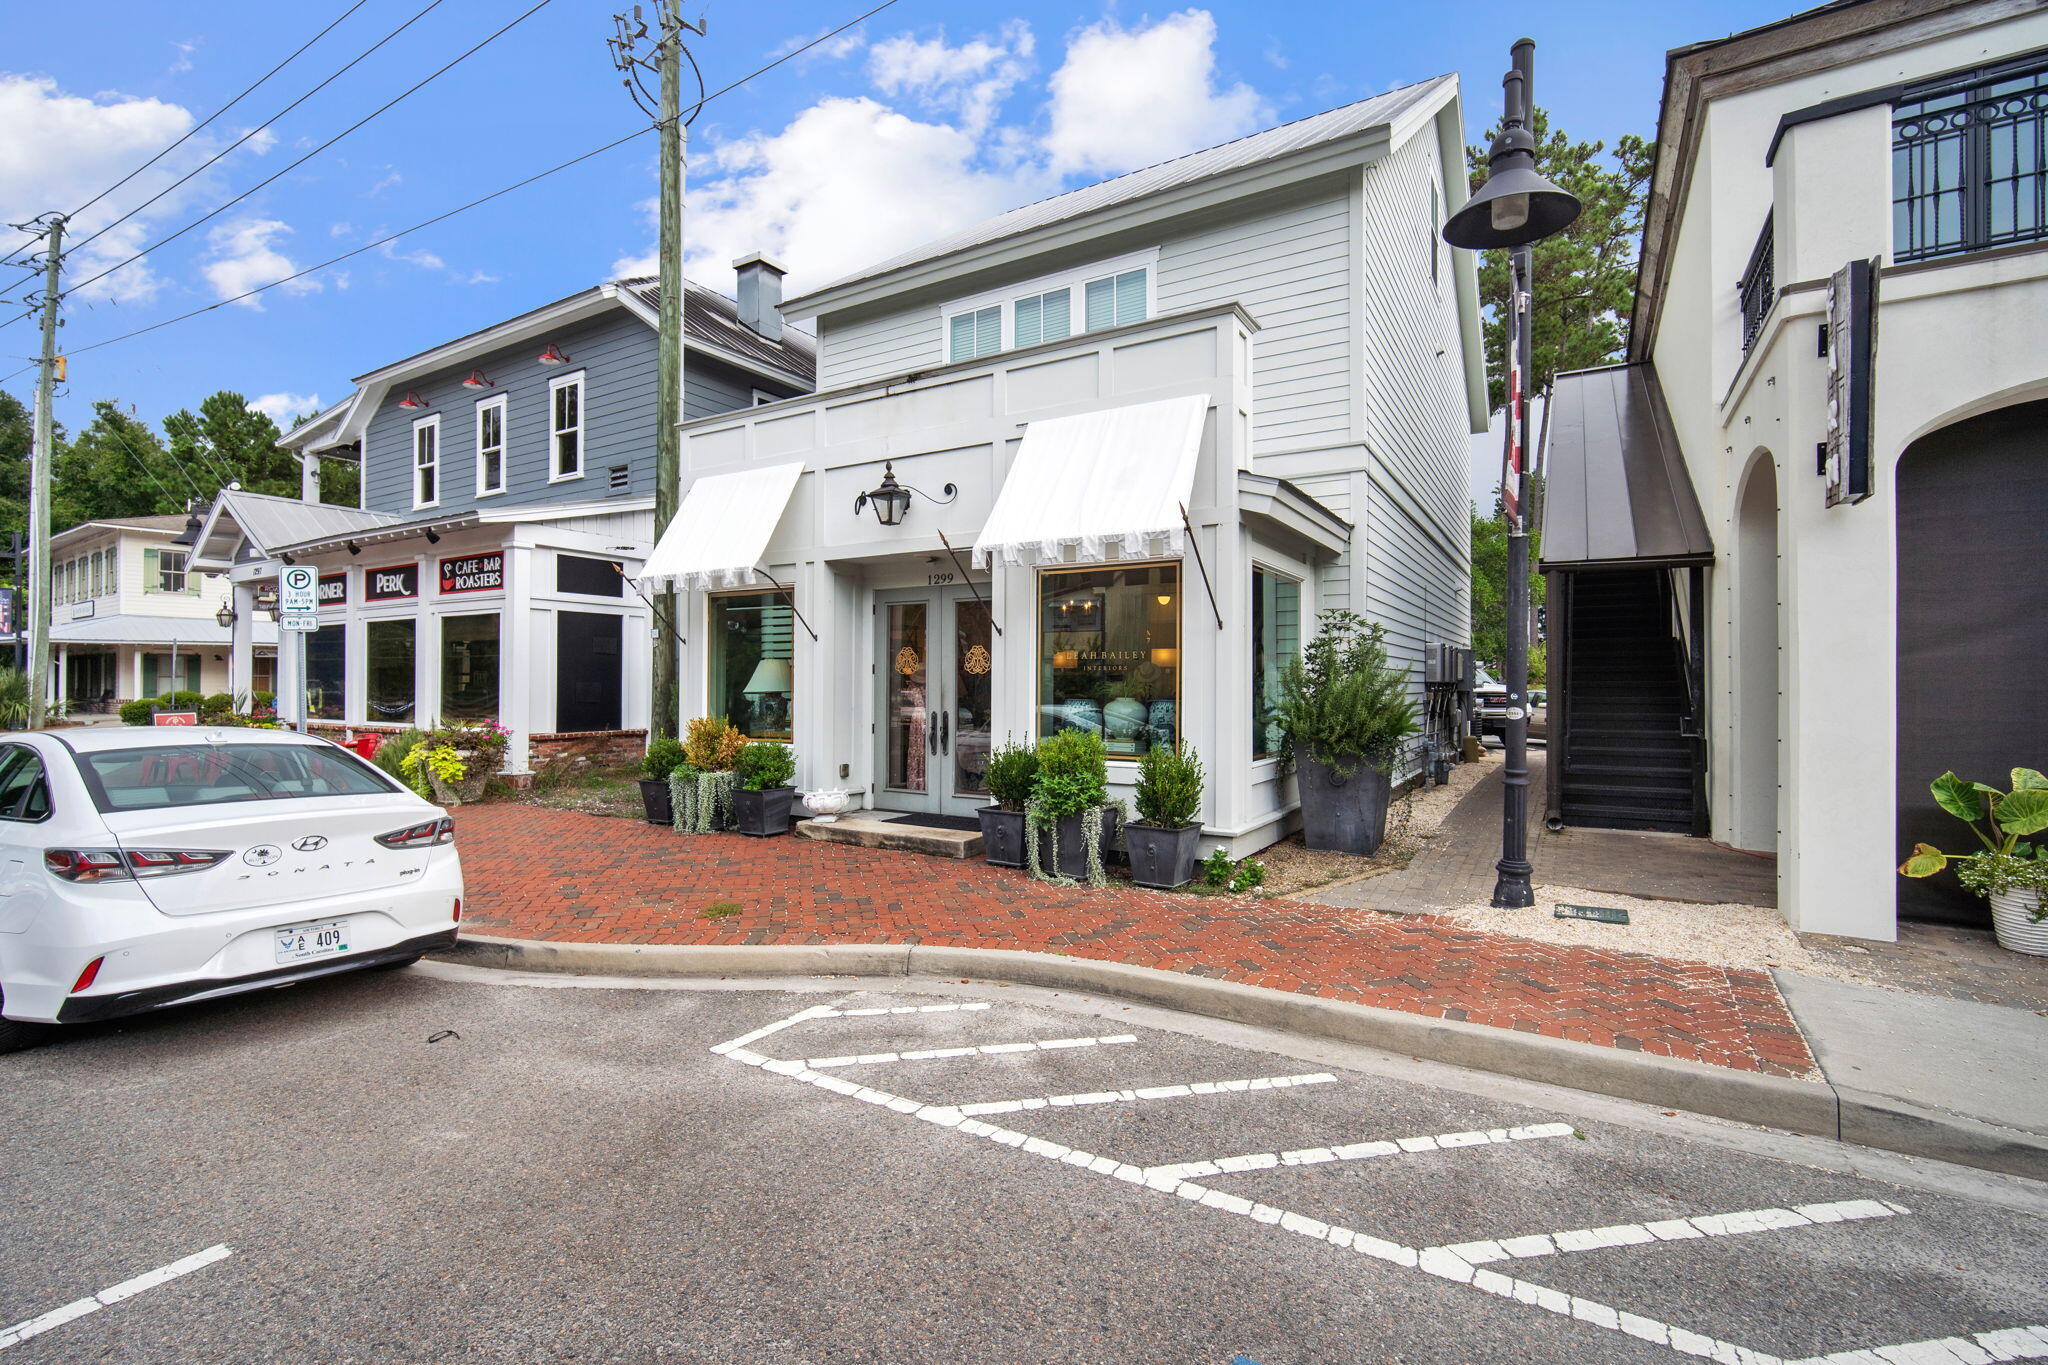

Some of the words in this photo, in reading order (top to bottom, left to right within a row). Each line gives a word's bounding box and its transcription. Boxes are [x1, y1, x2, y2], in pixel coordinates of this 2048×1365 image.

[455, 559, 478, 574] CAFE
[484, 557, 501, 571] BAR
[294, 573, 306, 586] P
[455, 573, 501, 589] ROASTERS
[928, 573, 954, 585] 1299
[319, 582, 344, 600] RNER
[1101, 650, 1146, 660] BAILEY
[238, 858, 375, 880] SONATA
[317, 930, 340, 947] 409
